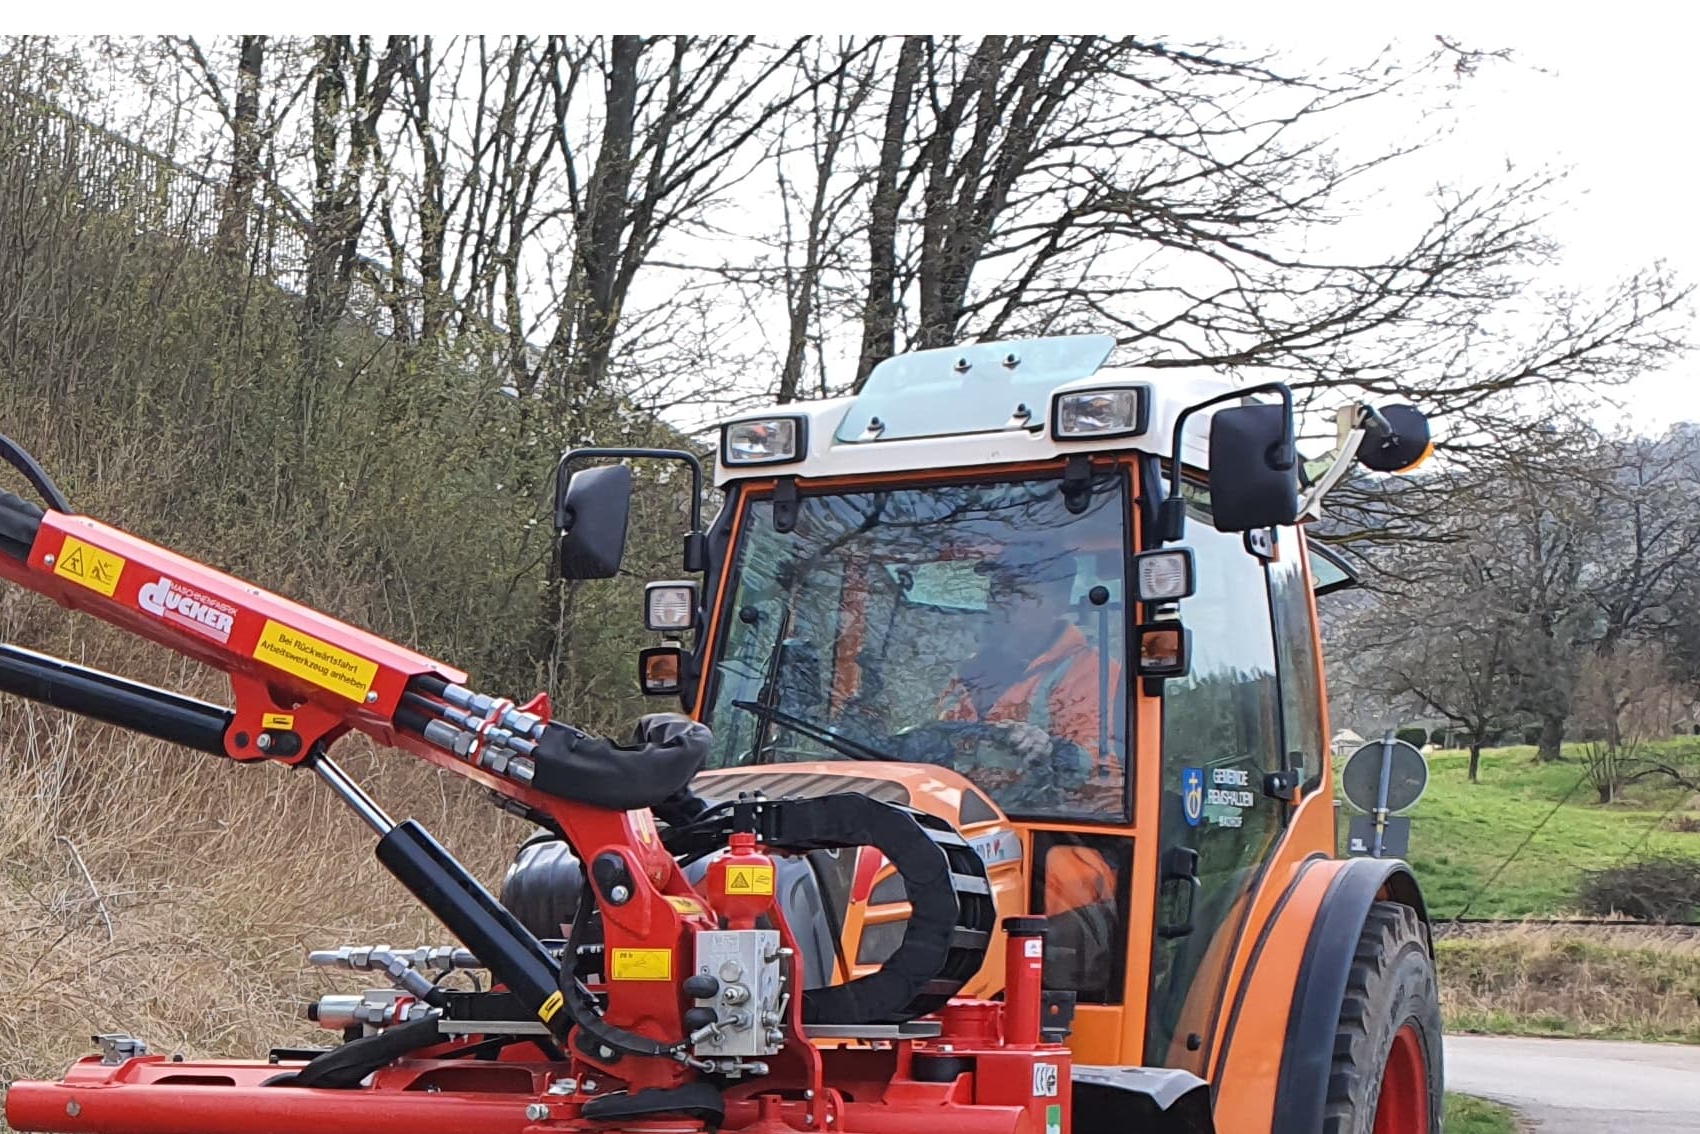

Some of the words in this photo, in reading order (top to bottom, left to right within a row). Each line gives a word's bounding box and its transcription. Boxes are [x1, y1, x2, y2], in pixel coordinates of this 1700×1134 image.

[260, 640, 329, 676] Arbeitswerkzeug
[329, 670, 367, 690] anheben
[278, 633, 294, 647] Bei
[293, 639, 358, 674] Rückwärtsfahrt
